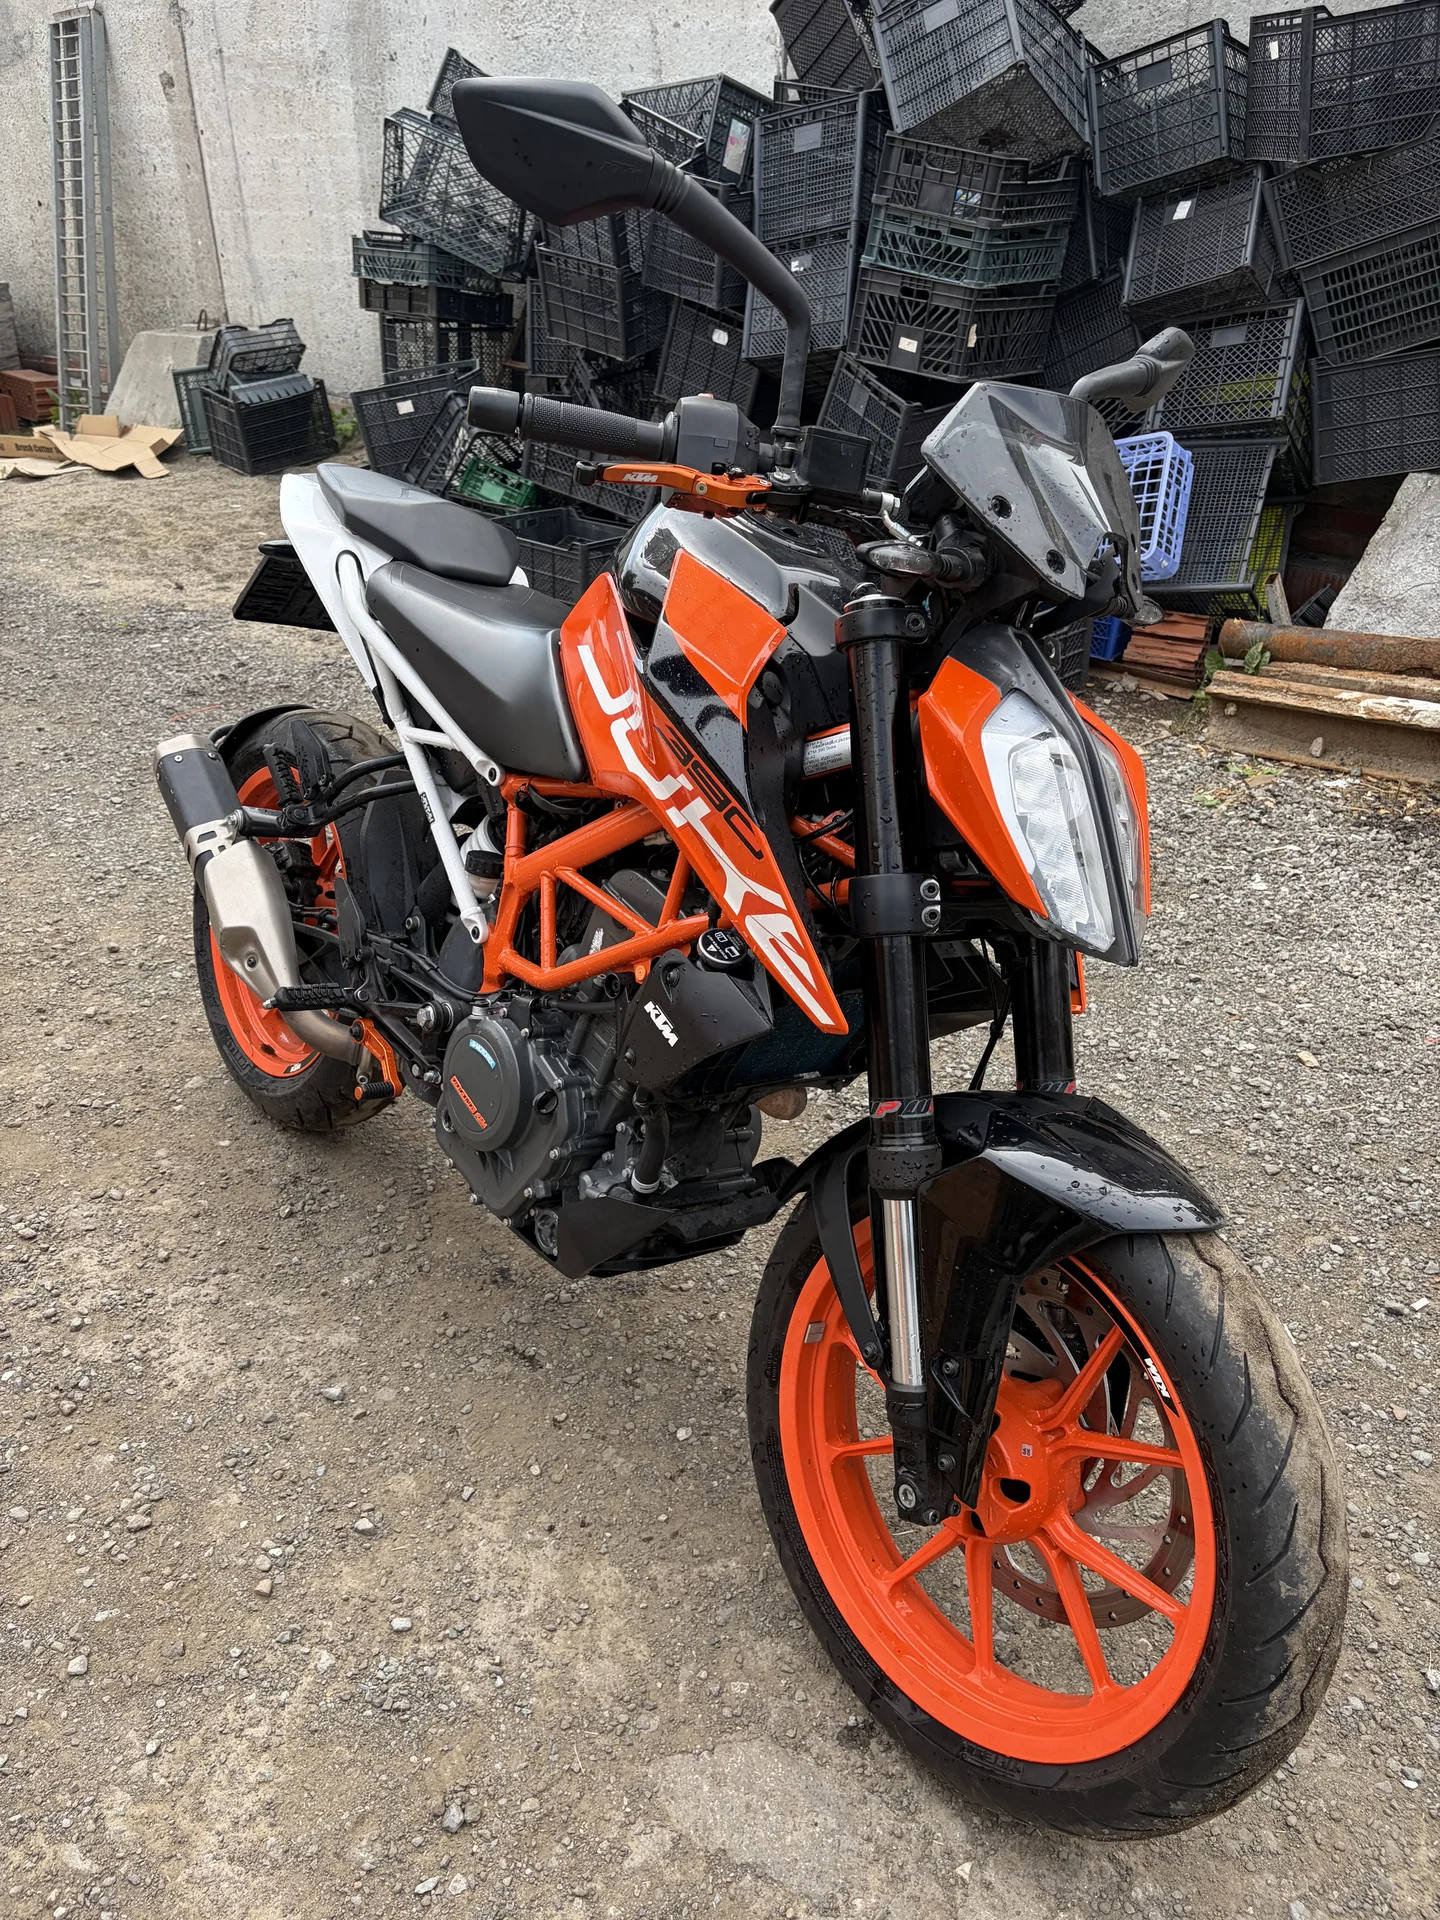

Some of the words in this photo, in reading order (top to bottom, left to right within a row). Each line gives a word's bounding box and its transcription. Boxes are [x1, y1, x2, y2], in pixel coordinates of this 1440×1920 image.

[622, 471, 658, 482] KTM
[653, 722, 763, 860] 390
[577, 644, 834, 1025] DUKE
[643, 1000, 679, 1047] KTM
[1144, 1357, 1171, 1398] KTM
